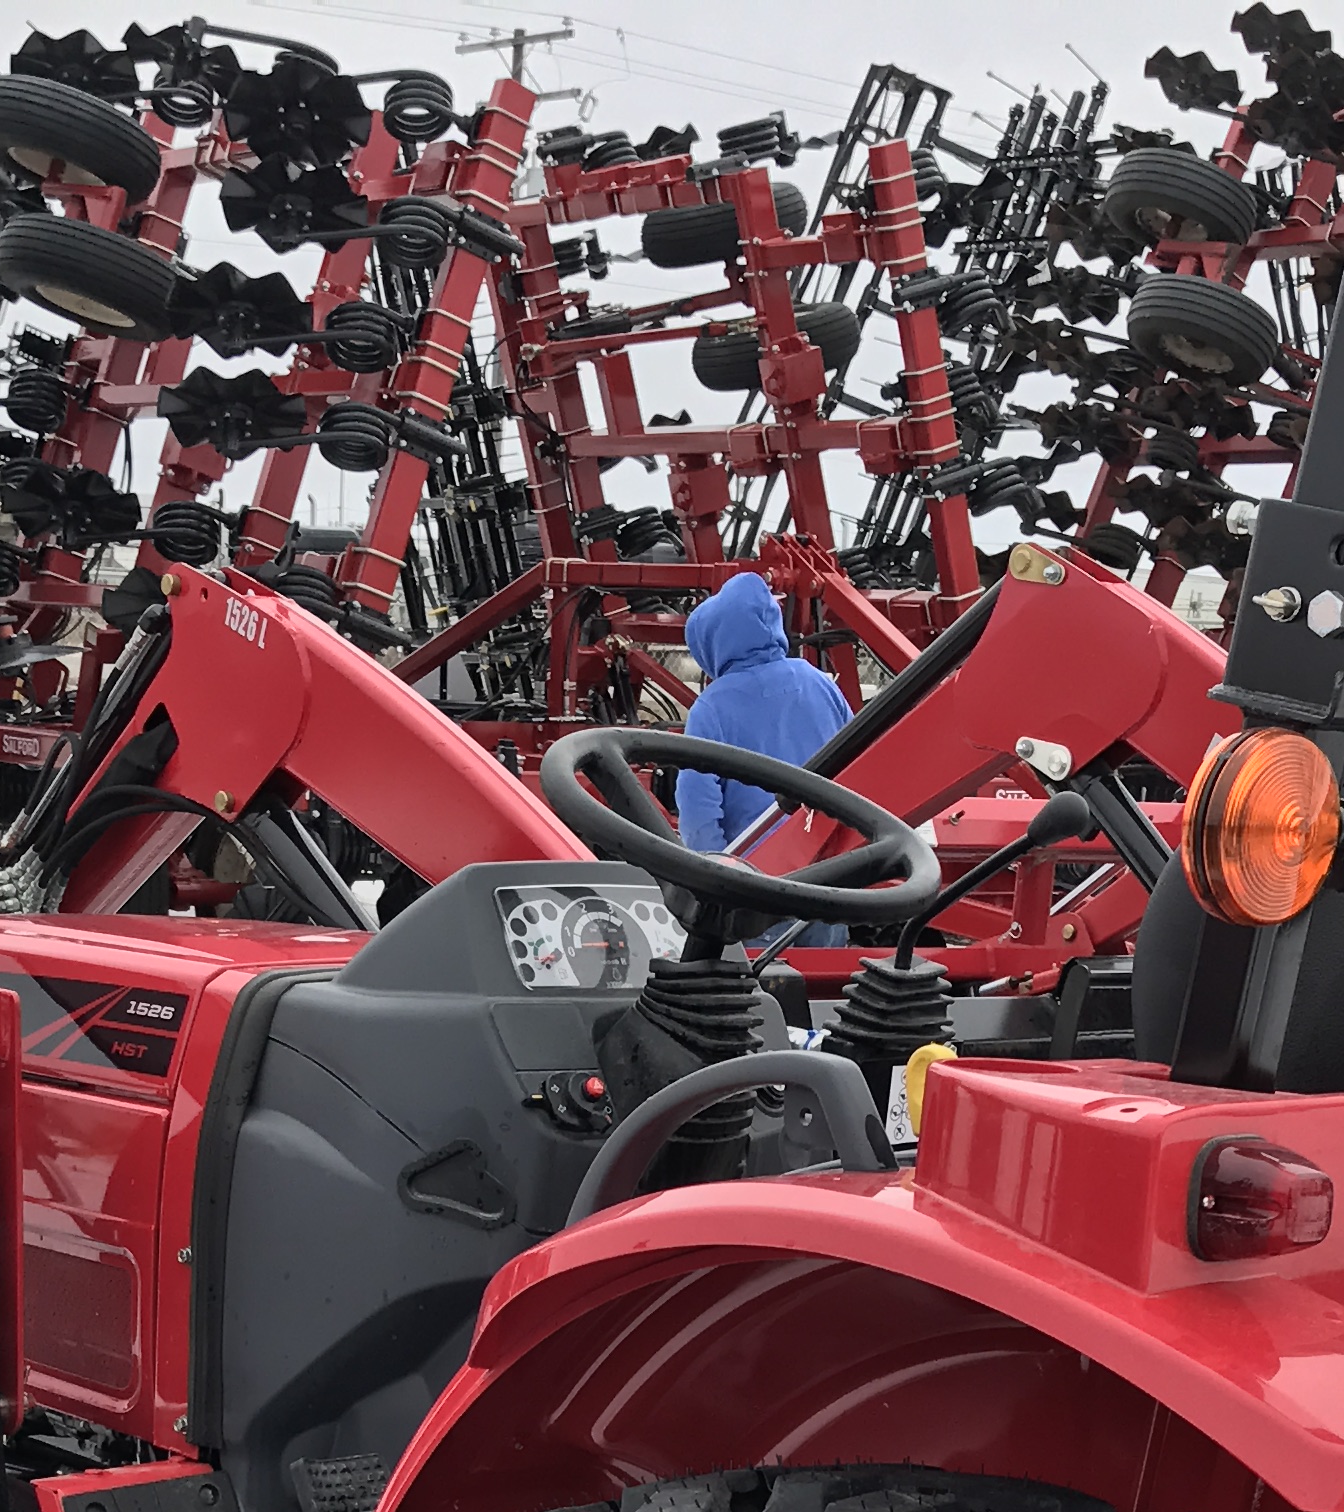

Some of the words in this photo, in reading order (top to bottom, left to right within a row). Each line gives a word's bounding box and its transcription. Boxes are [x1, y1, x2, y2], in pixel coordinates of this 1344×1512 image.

[224, 596, 259, 641] 1526
[257, 617, 268, 649] L
[2, 734, 40, 757] SALFORD
[580, 903, 588, 914] 2
[606, 903, 614, 914] 3
[126, 1001, 176, 1020] 1526
[111, 1040, 149, 1059] HST
